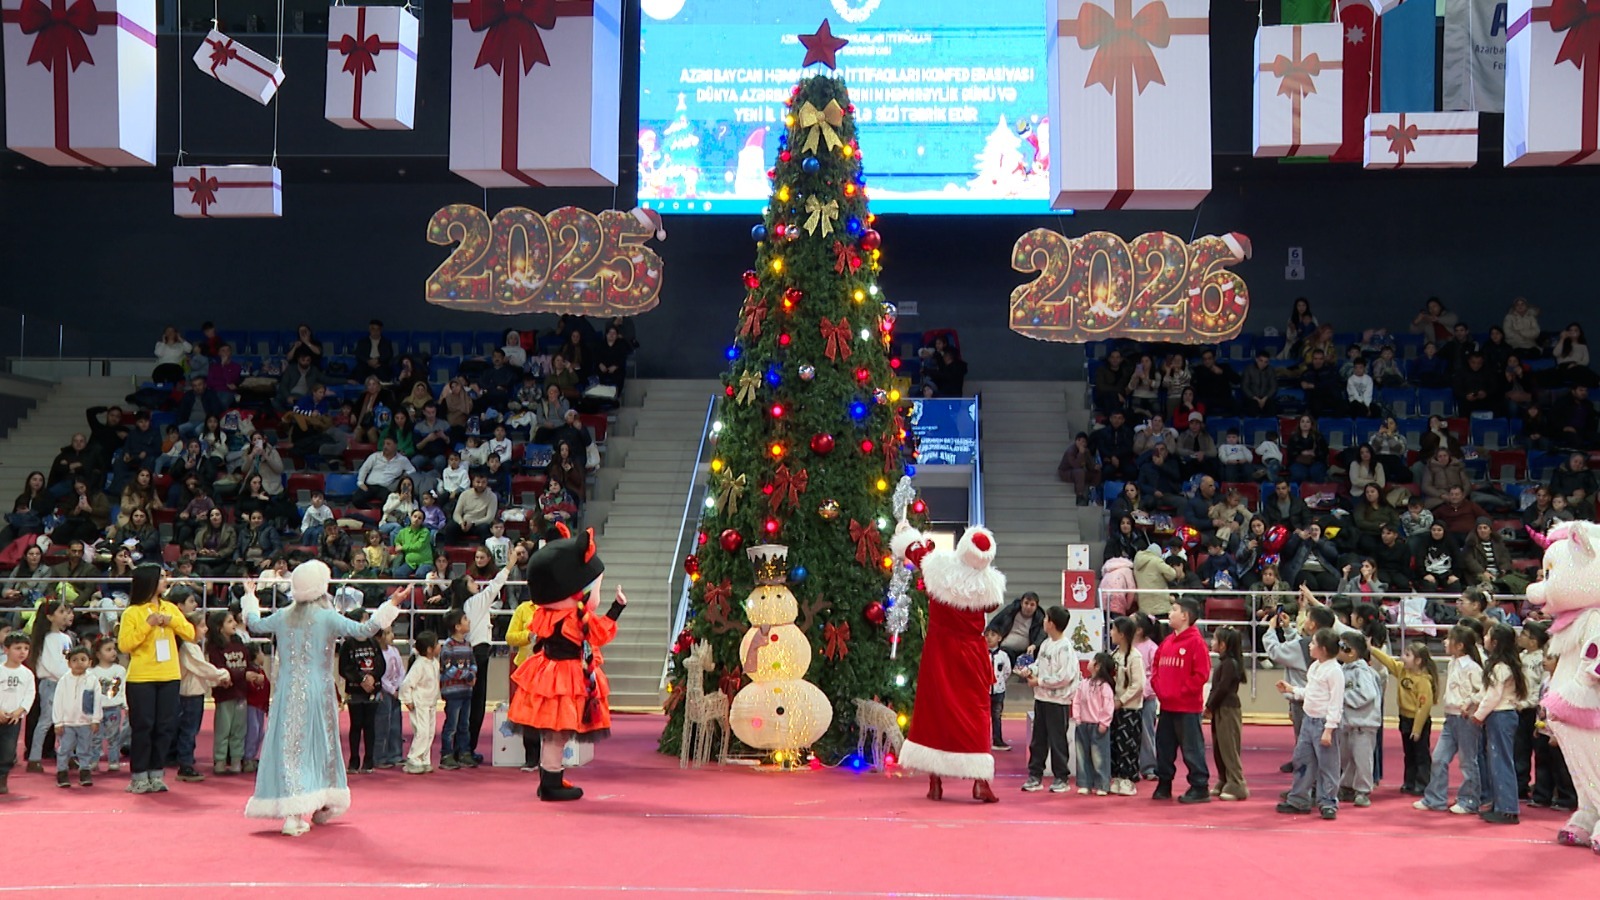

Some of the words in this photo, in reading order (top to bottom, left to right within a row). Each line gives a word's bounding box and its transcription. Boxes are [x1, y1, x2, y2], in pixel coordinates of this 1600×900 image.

[696, 86, 739, 102] DÜNYA
[734, 105, 763, 122] YENİ
[426, 204, 664, 317] 2025
[1009, 228, 1251, 343] 2026
